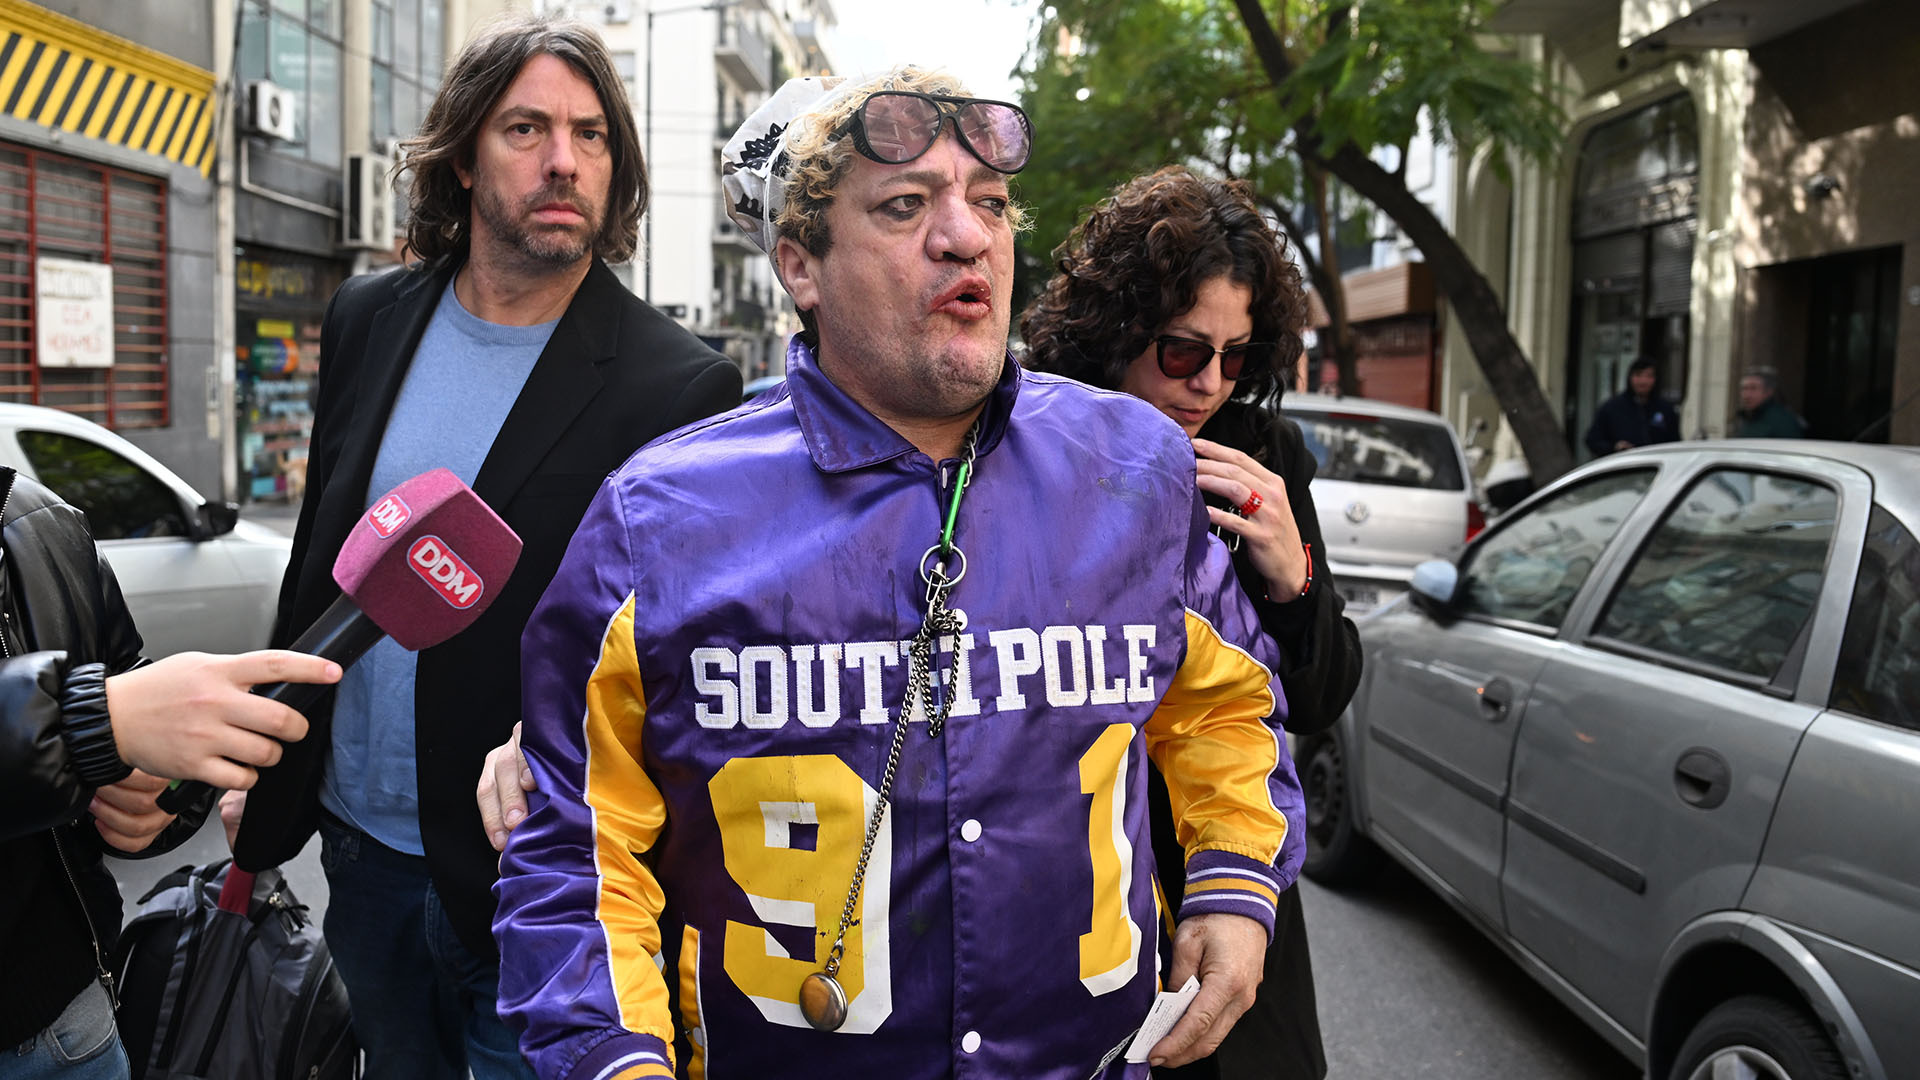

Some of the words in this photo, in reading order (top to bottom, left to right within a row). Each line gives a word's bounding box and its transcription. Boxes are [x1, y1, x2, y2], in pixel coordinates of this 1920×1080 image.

[372, 498, 406, 533] DDM
[413, 540, 479, 604] DDM
[690, 633, 981, 730] SOUTH
[988, 624, 1157, 713] POLE
